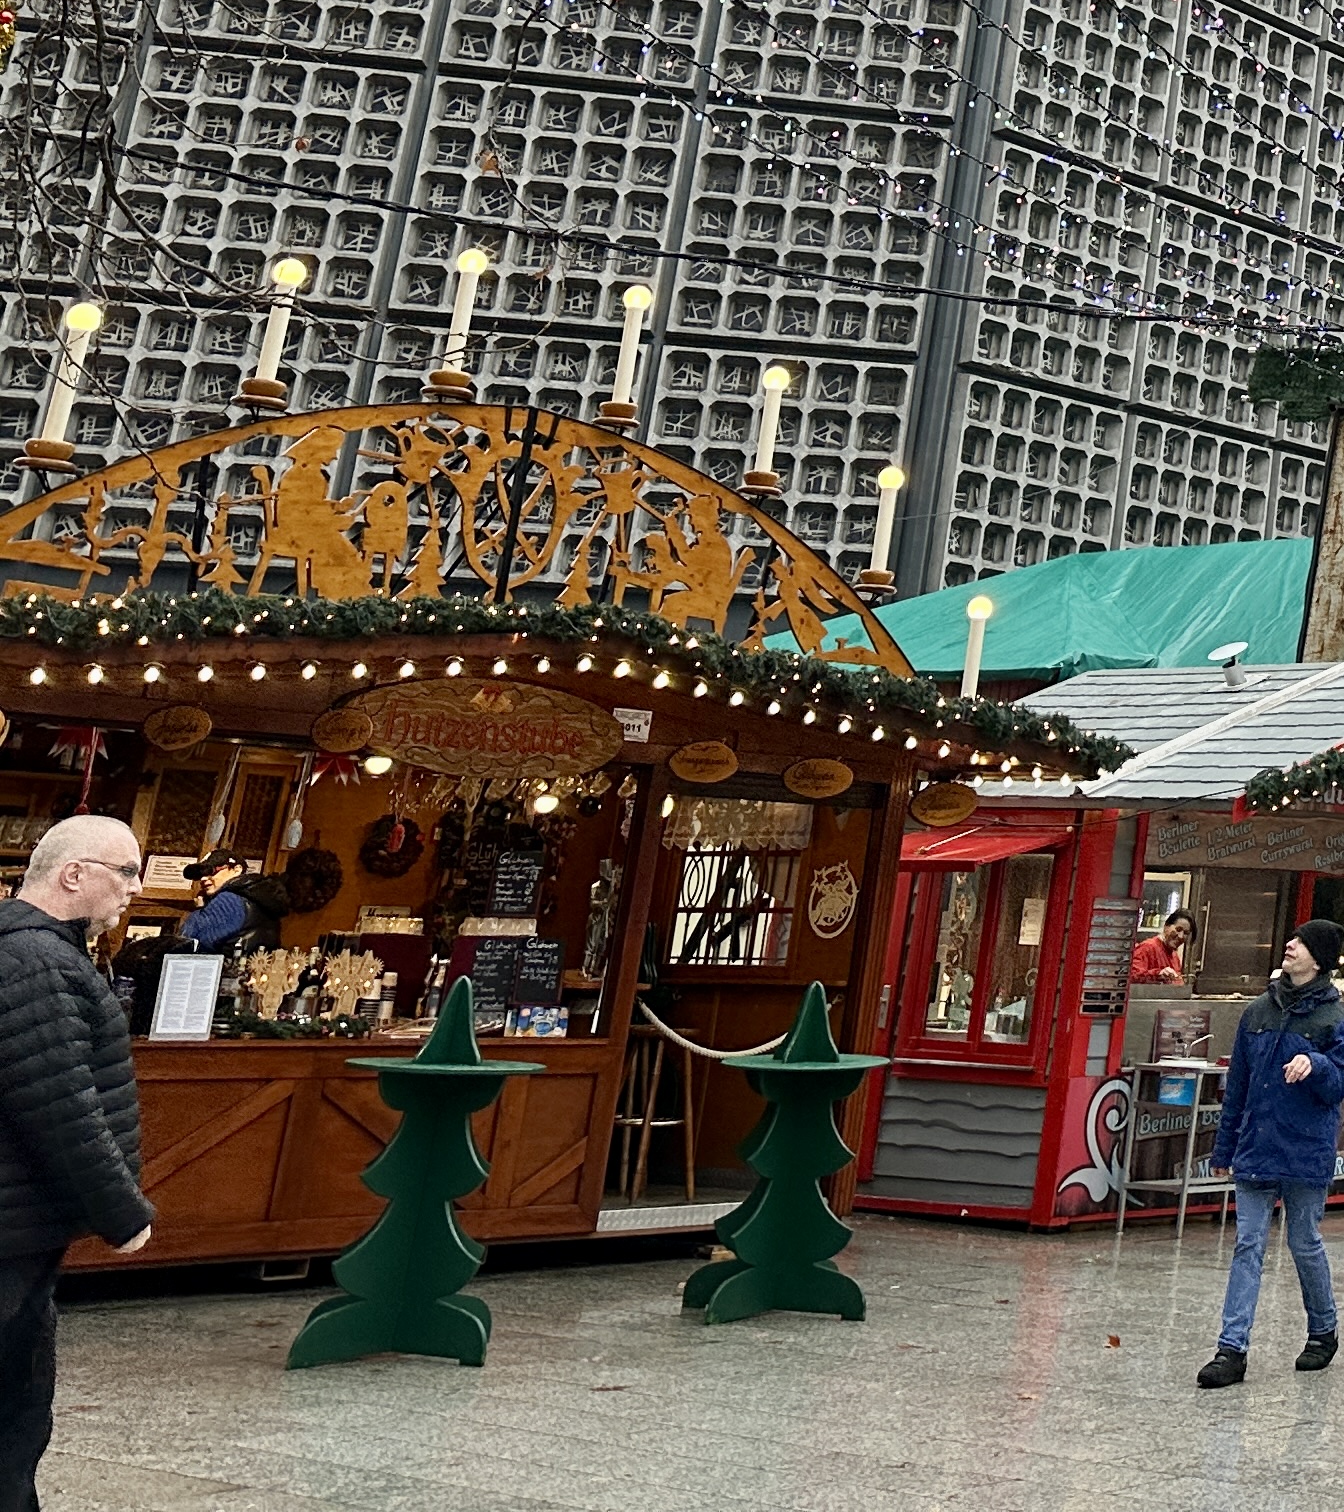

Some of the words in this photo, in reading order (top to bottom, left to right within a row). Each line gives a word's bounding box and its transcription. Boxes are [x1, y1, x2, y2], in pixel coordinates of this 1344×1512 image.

[623, 722, 642, 733] 011
[1157, 820, 1200, 841] Berliner
[1266, 825, 1306, 846] Berliner
[1158, 836, 1201, 858] Boulette
[1207, 835, 1257, 861] Bratwurst
[1260, 837, 1314, 864] Currywurst
[1139, 1110, 1193, 1135] Berline
